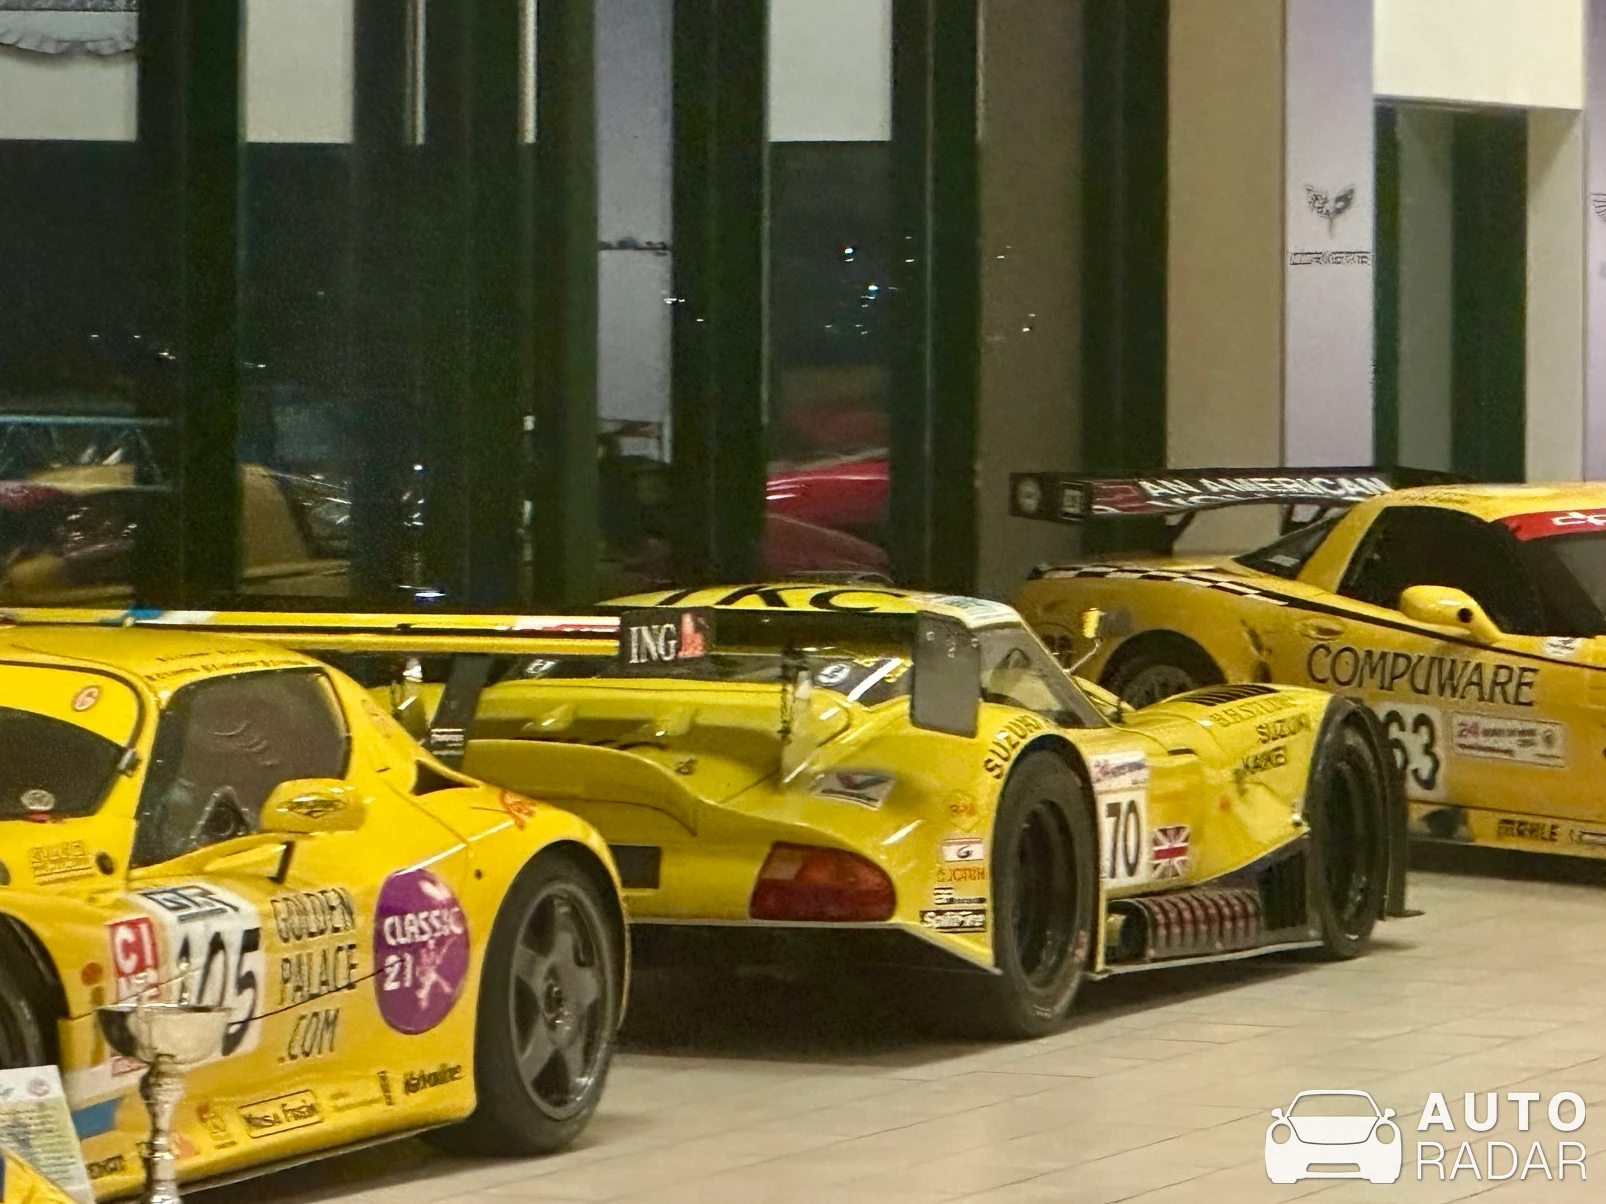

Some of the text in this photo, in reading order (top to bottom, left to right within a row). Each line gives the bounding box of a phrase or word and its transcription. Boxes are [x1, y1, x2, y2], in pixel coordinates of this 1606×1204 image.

[1137, 477, 1395, 497] AN AMERICAN
[629, 624, 677, 664] ING
[1307, 643, 1540, 707] COMPUWARE
[1382, 709, 1440, 791] 63
[1105, 800, 1140, 879] 70
[270, 887, 356, 943] GOLDEN
[383, 907, 464, 946] CLASSIC
[278, 943, 357, 1006] PALACE
[383, 953, 415, 991] 21
